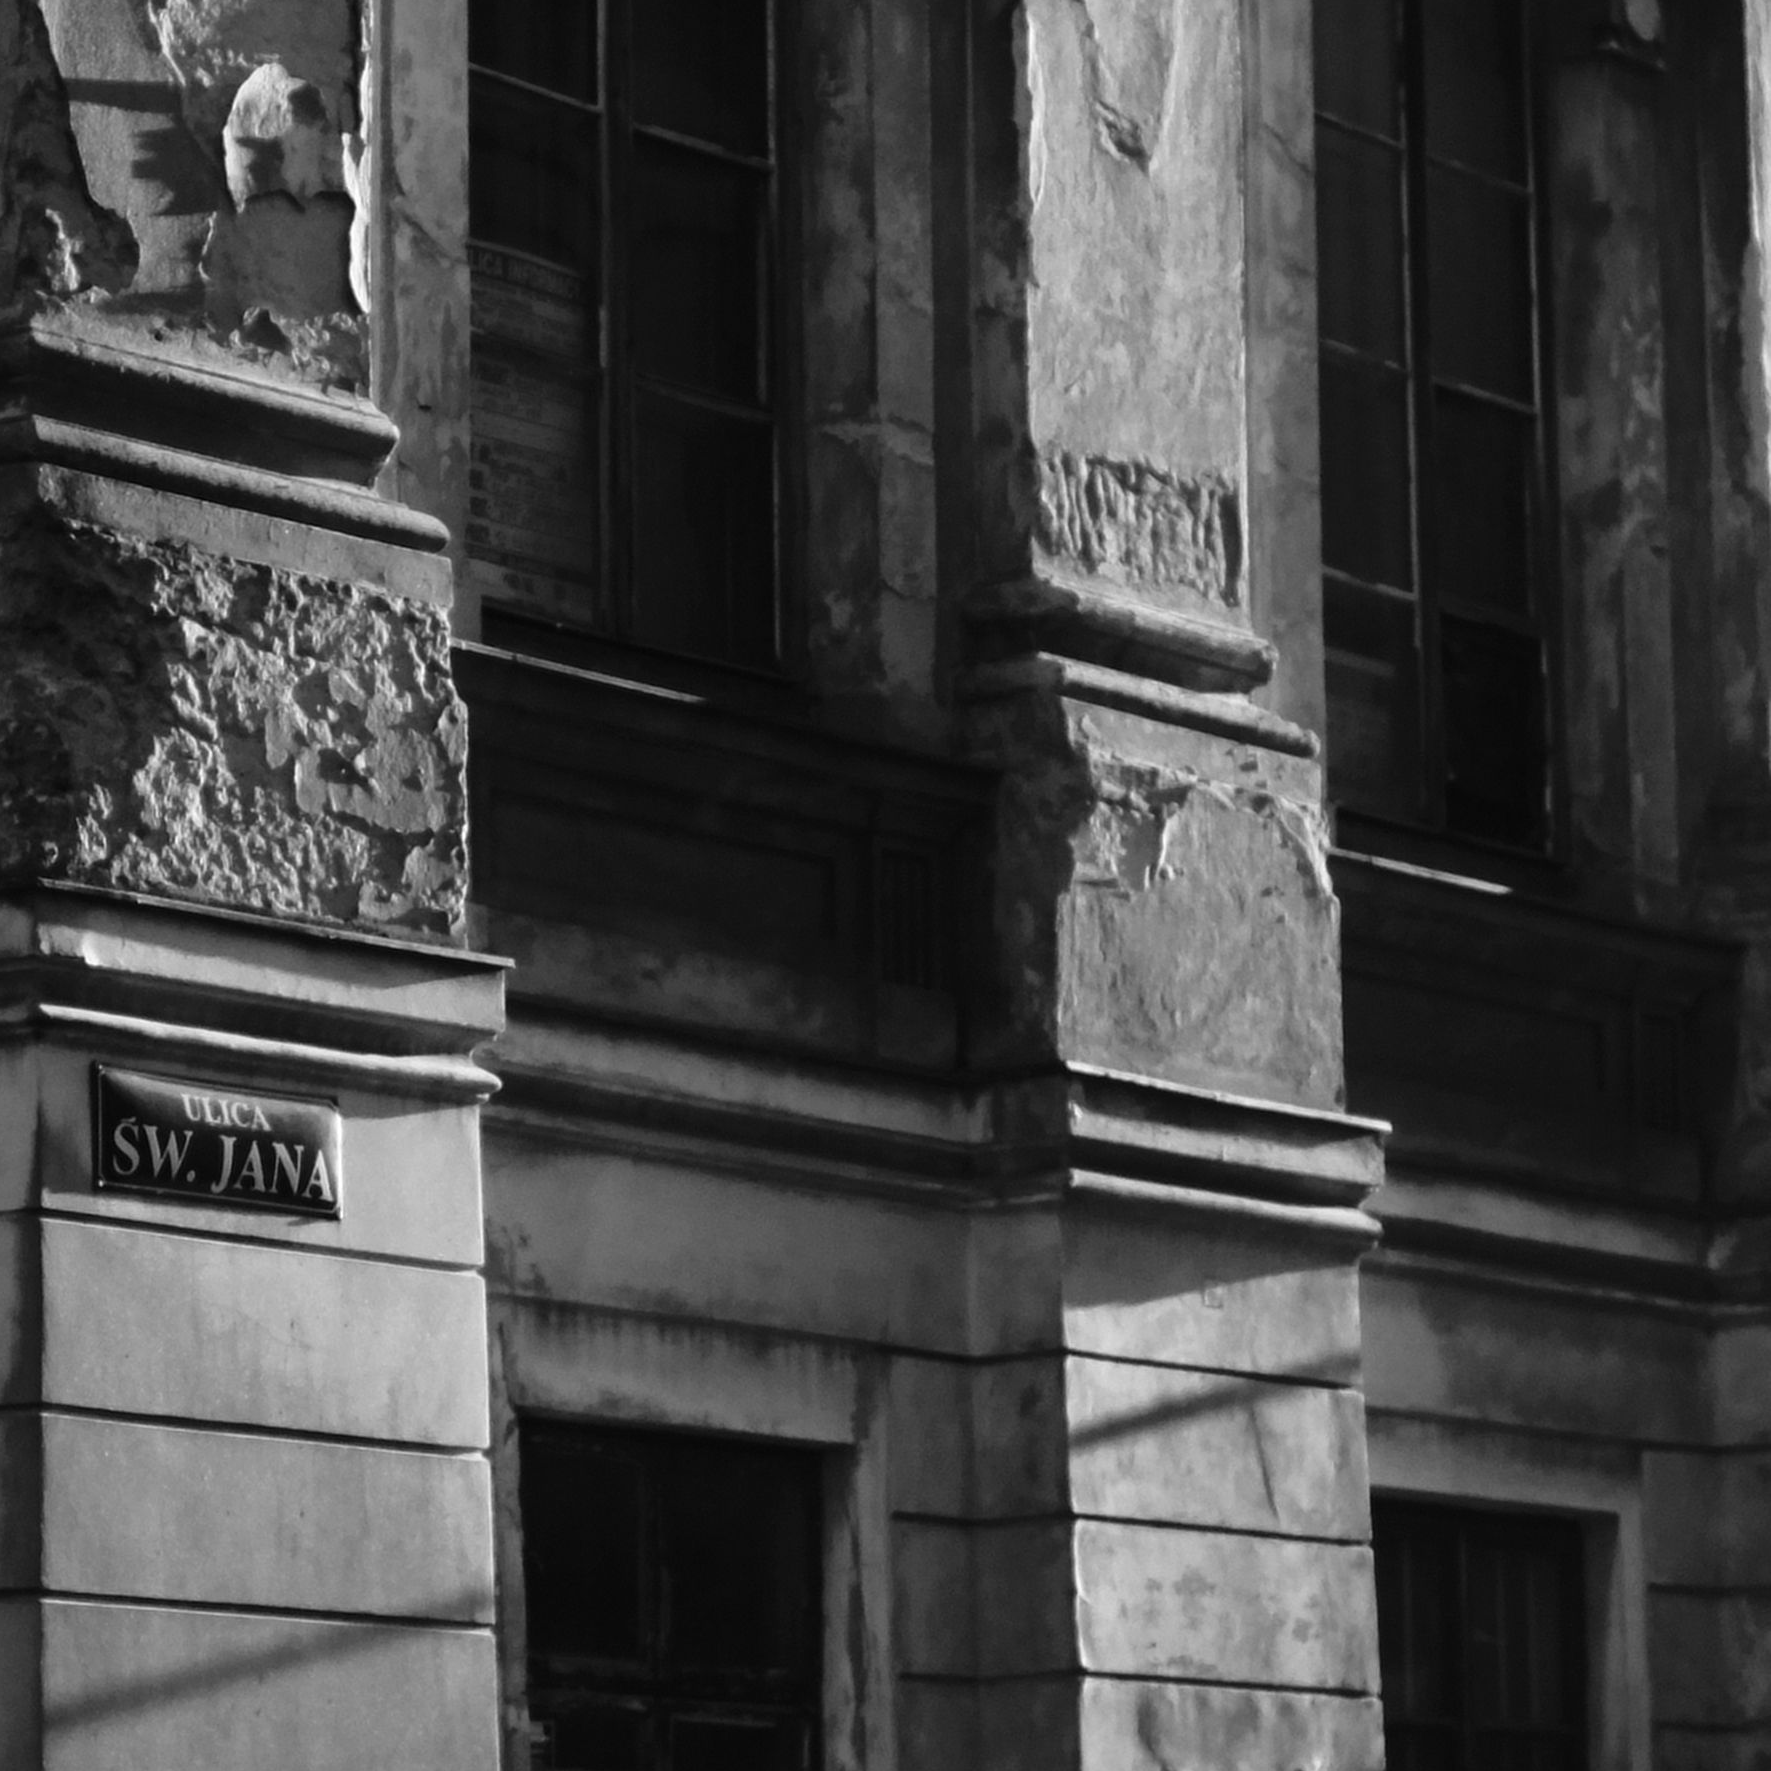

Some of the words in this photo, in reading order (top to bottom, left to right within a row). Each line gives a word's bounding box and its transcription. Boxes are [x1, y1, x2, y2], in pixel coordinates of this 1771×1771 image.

[180, 1093, 272, 1132] ULICA
[111, 1116, 196, 1184] ŚW.
[210, 1134, 336, 1204] JANA
